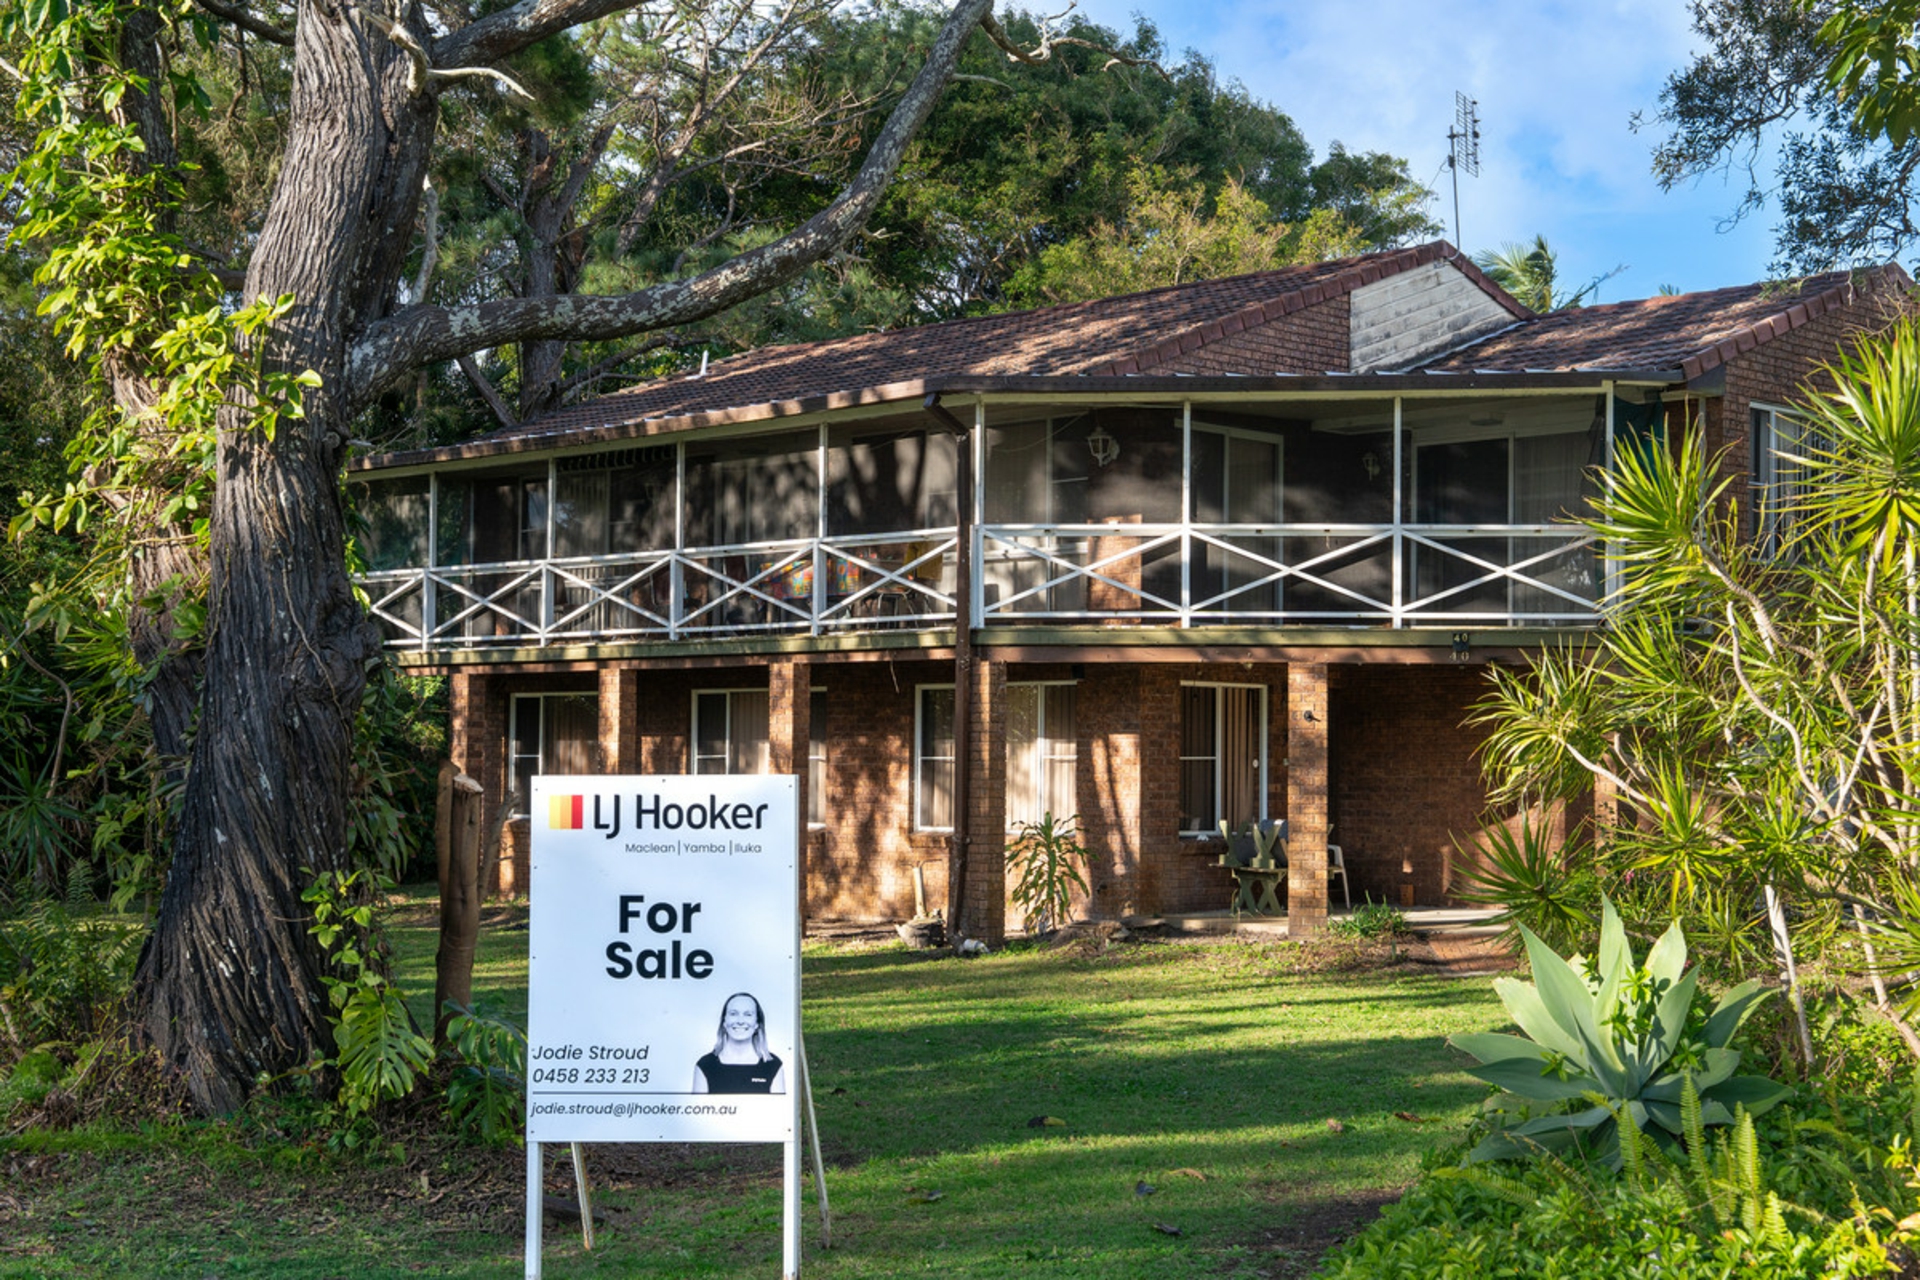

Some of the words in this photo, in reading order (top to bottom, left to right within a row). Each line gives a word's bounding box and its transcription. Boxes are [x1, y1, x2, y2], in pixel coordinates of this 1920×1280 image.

[593, 794, 621, 840] LJ
[635, 794, 769, 830] Hooker
[625, 843, 676, 853] Maclean
[683, 843, 726, 853] Yamba
[734, 843, 762, 853] Iluka
[618, 894, 702, 934] For
[605, 939, 715, 980] Sale
[533, 1045, 583, 1060] Jodie
[588, 1045, 649, 1060] Stroud
[532, 1067, 579, 1084] 0458
[584, 1067, 616, 1084] 233
[622, 1067, 650, 1084] 213
[530, 1102, 737, 1118] jodie.stroud@ljhooker.com.au
